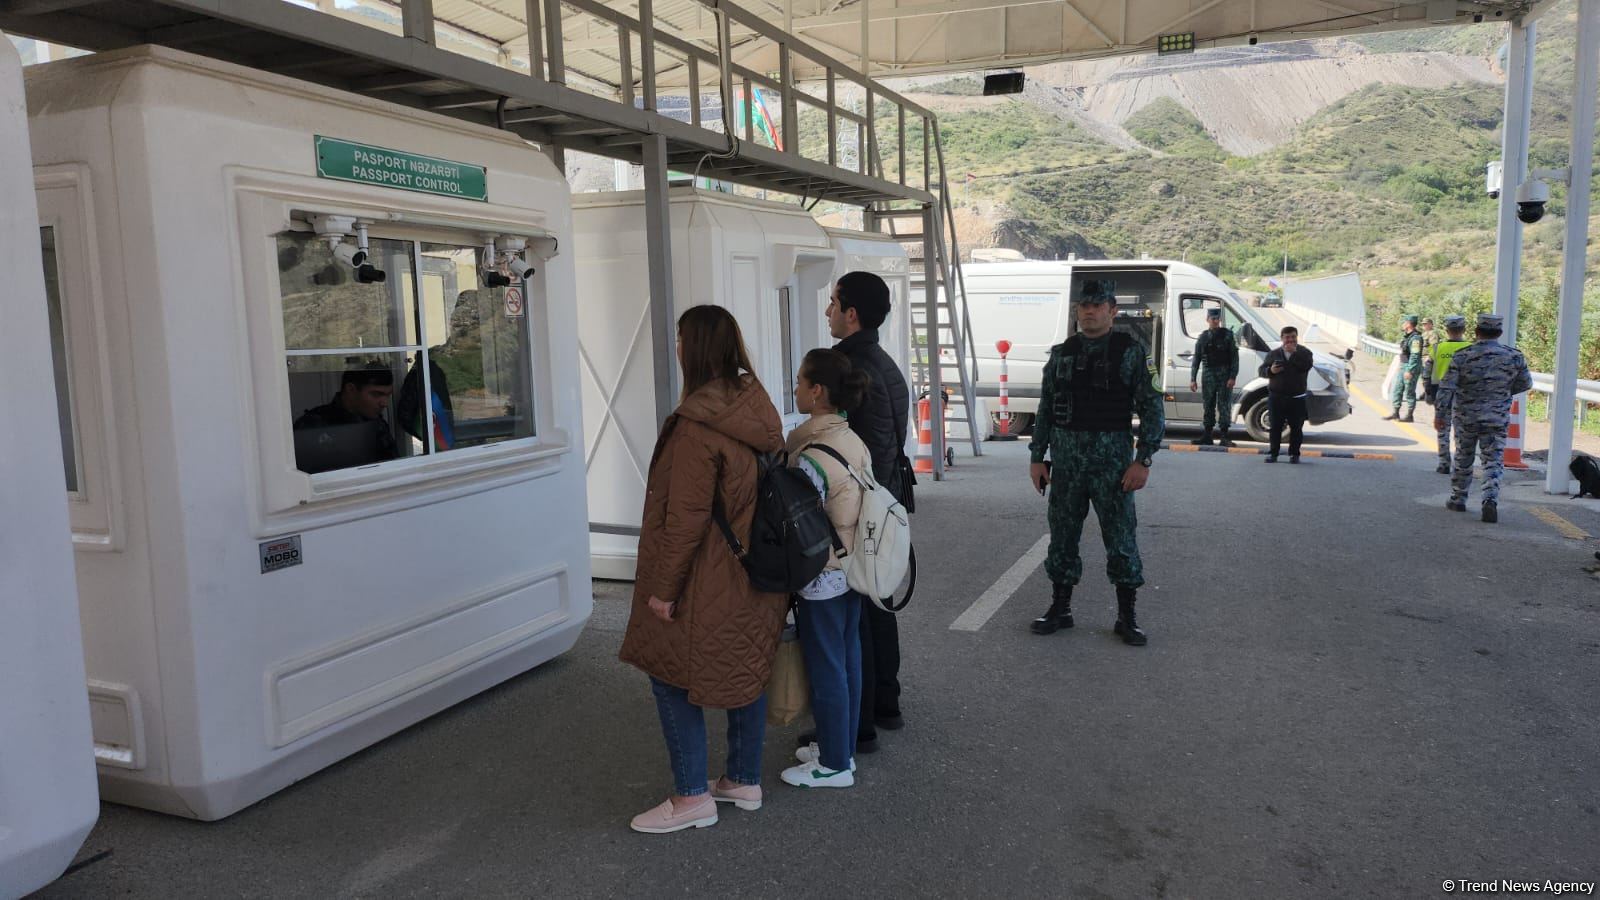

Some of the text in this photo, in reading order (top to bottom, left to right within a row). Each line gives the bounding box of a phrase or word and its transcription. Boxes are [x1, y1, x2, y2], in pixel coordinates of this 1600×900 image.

[354, 150, 407, 169] PASPORT
[352, 166, 463, 193] PASSPORT CONTROL
